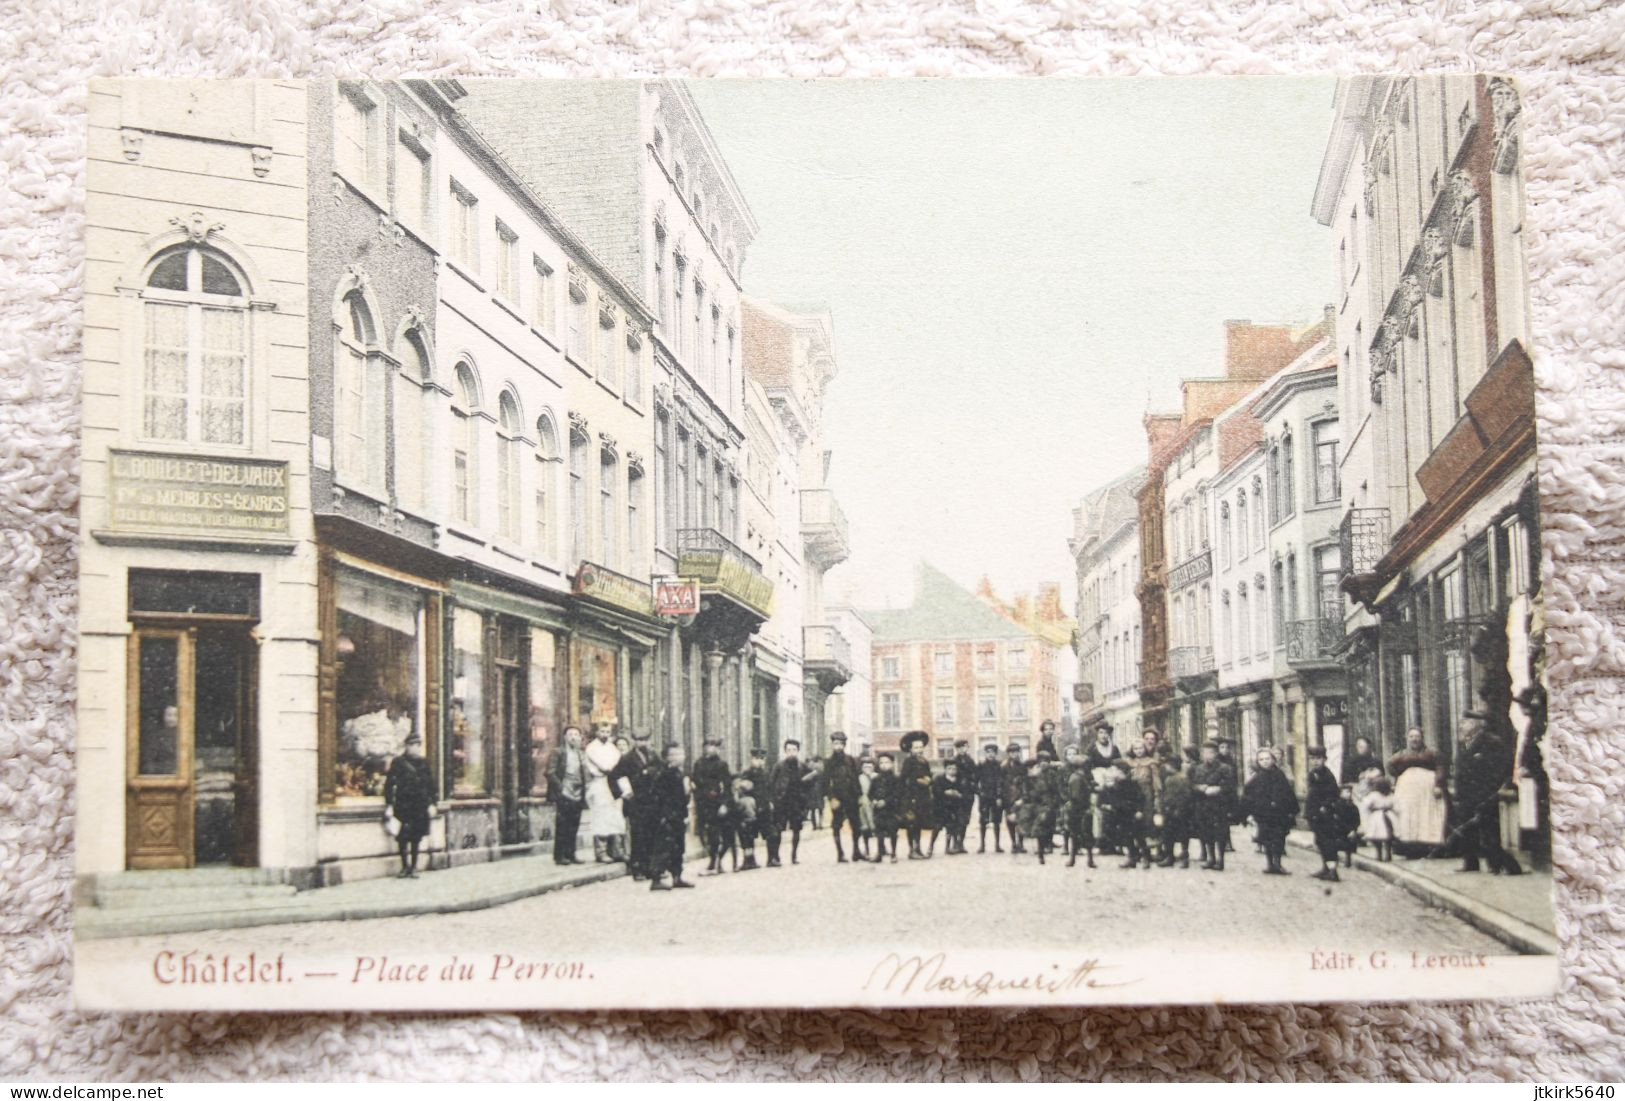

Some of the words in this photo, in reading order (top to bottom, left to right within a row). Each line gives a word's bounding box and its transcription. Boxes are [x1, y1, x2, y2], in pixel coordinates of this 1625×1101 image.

[157, 489, 223, 509] MEUBLES
[658, 584, 695, 605] AXA
[153, 949, 292, 984] Châtelet.
[351, 956, 429, 983] Place
[440, 955, 474, 982] du
[489, 954, 595, 981] Perron.
